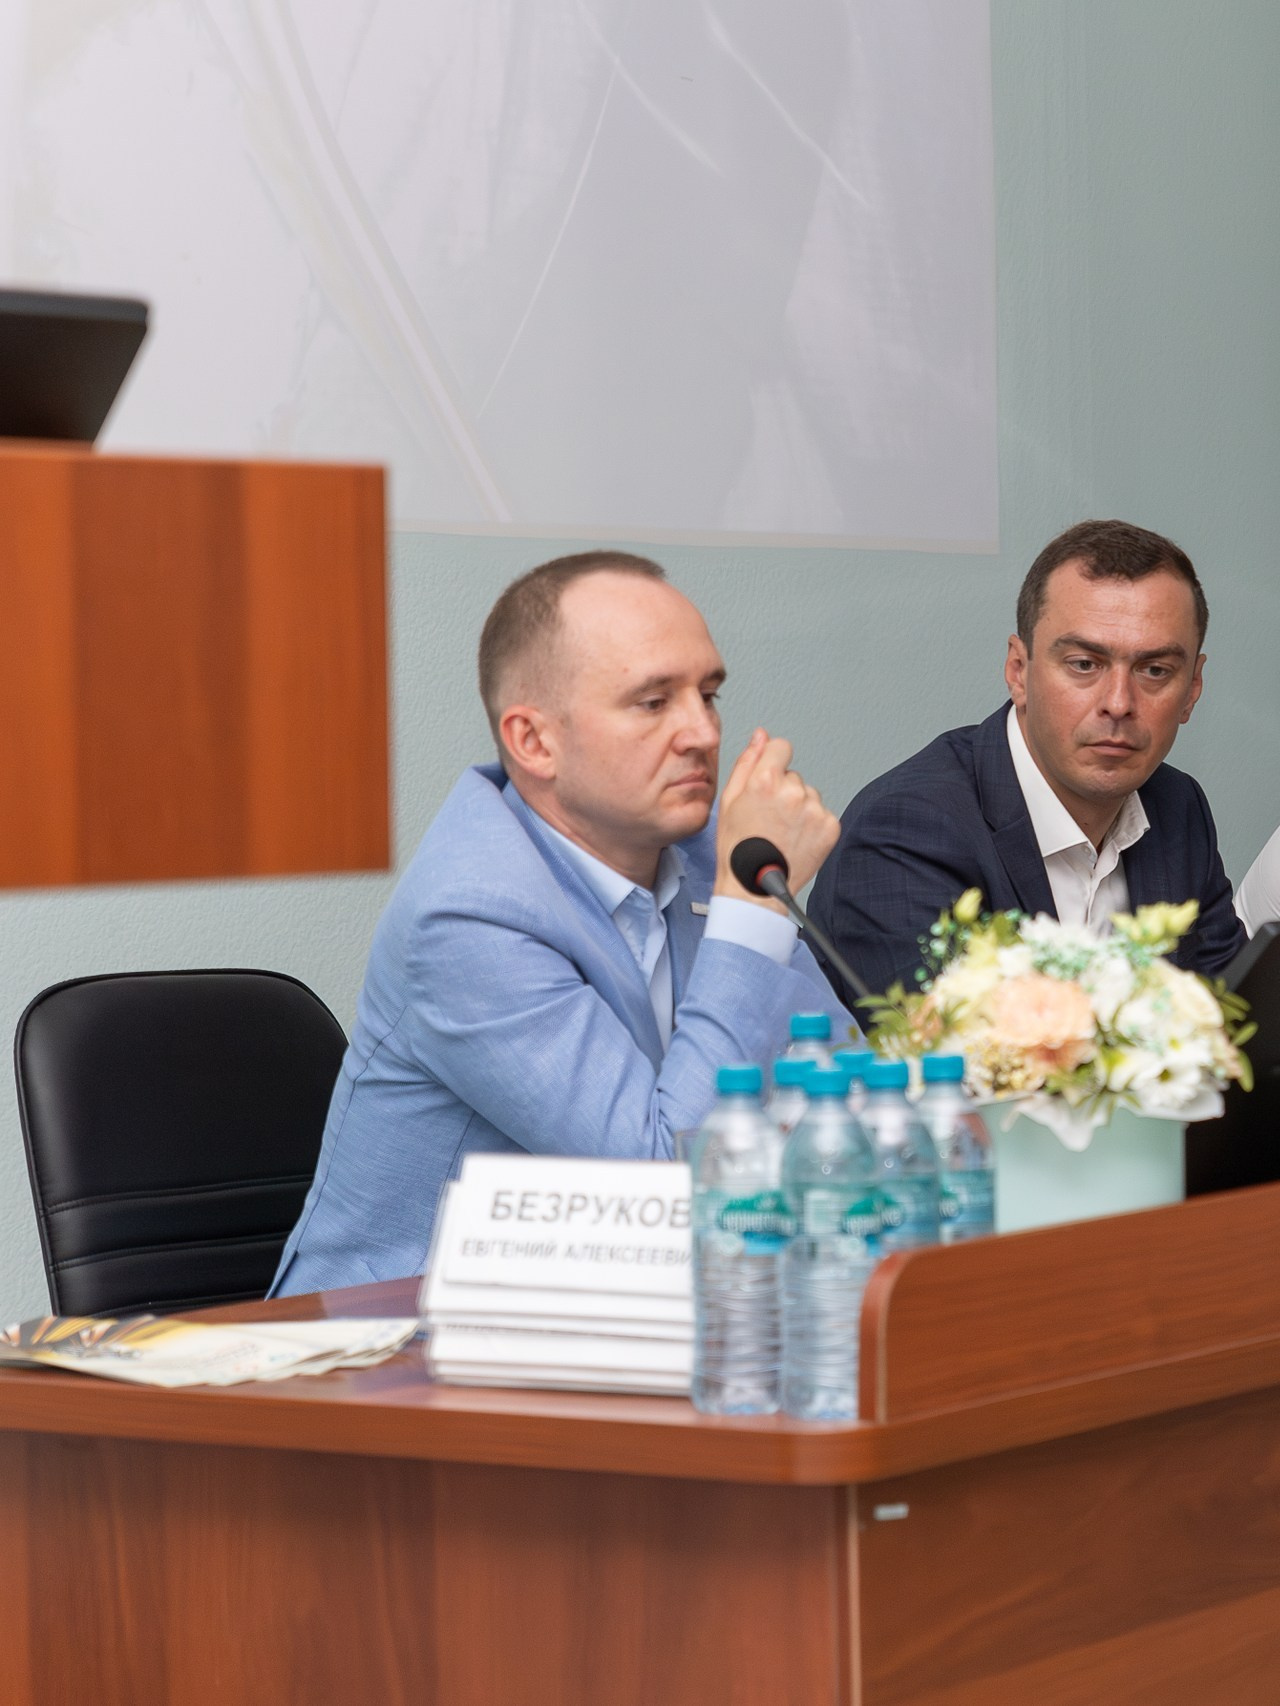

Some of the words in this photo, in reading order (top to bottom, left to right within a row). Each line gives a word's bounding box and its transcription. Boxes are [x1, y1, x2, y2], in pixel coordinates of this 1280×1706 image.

[490, 1189, 691, 1229] БЕЗРУКОВ
[460, 1237, 558, 1259] ЕВГЕНИЙ
[564, 1243, 692, 1267] АЛЕКСЕЕВИ
